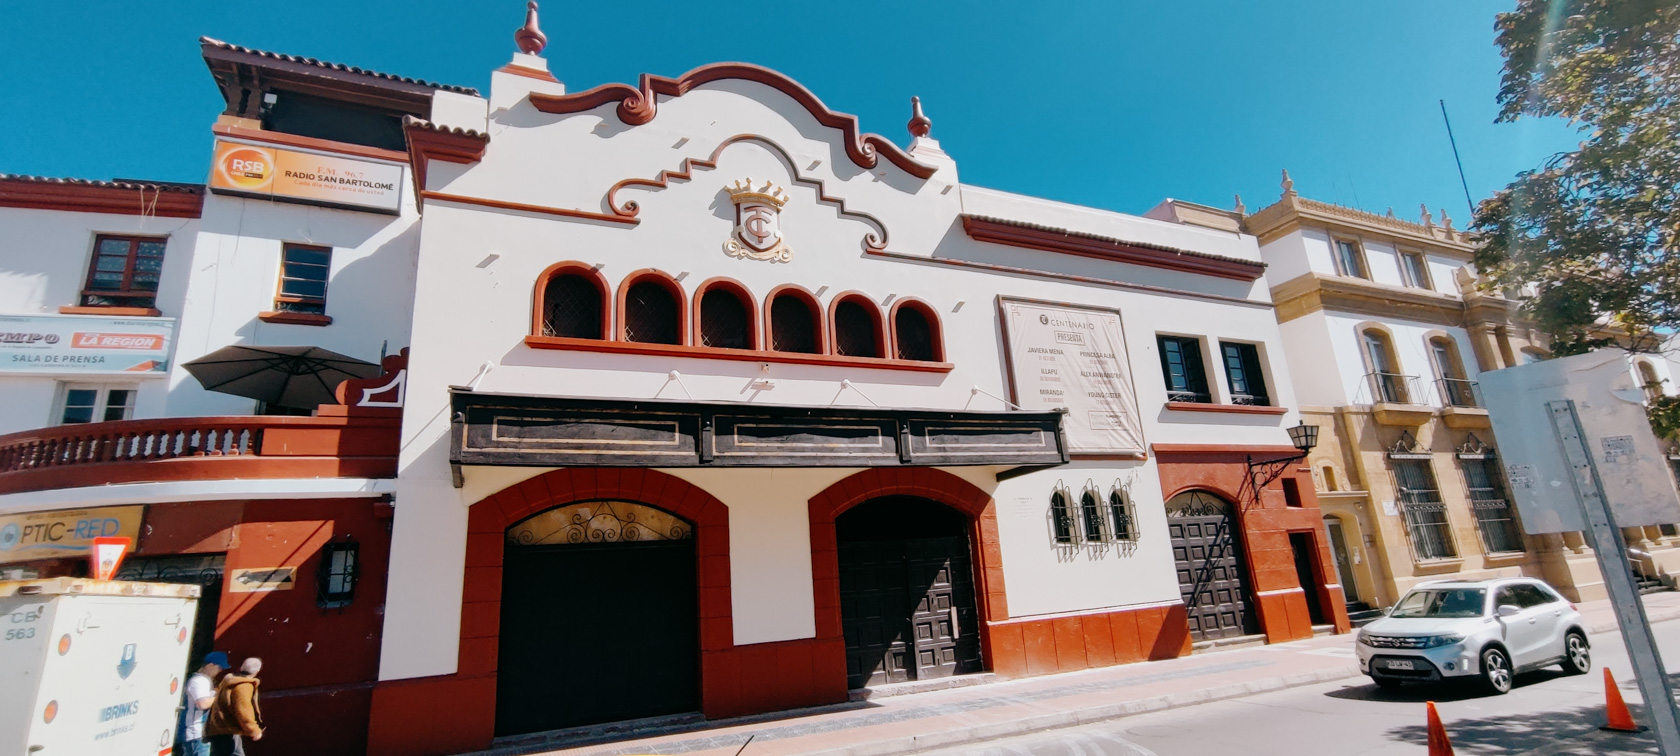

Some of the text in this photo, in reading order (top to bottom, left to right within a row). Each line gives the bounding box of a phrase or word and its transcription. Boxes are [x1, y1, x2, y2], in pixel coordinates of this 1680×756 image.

[232, 158, 264, 173] RSB
[317, 166, 364, 179] F.M. 96.7
[285, 170, 394, 191] RADIO SAN BARTOLOMÉ
[294, 179, 310, 187] Cada
[1050, 319, 1095, 330] CENTENARIO
[79, 336, 157, 347] LA REGION
[1056, 332, 1083, 342] PRESENTA
[12, 354, 105, 364] SALA DE PRENSA
[5, 627, 36, 641] 563
[103, 700, 139, 721] BRINKS
